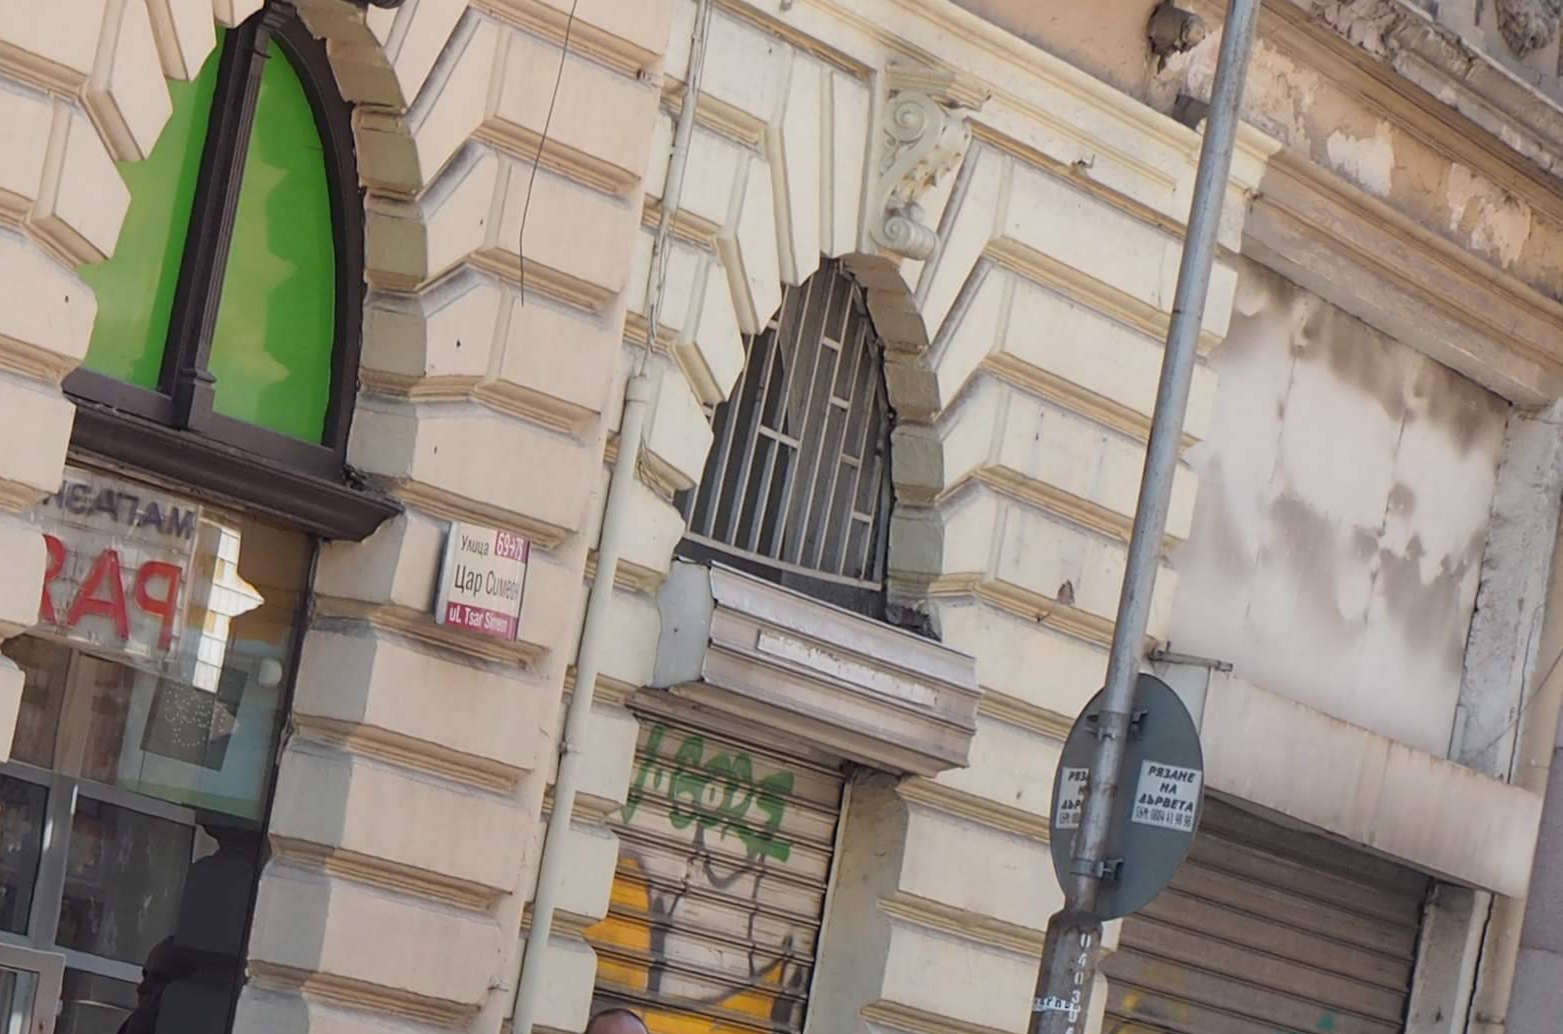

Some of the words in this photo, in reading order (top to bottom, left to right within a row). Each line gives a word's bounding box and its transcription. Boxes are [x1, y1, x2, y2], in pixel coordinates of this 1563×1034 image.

[461, 534, 490, 558] Улица
[454, 564, 483, 597] Цар
[464, 606, 484, 627] Tsar
[1068, 770, 1088, 782] РЯЗ
[1148, 765, 1197, 783] РЯЗАНЕ
[1159, 782, 1178, 795] НА
[1060, 799, 1082, 810] ДЪР
[1138, 793, 1194, 813] ДЪРВЕТА
